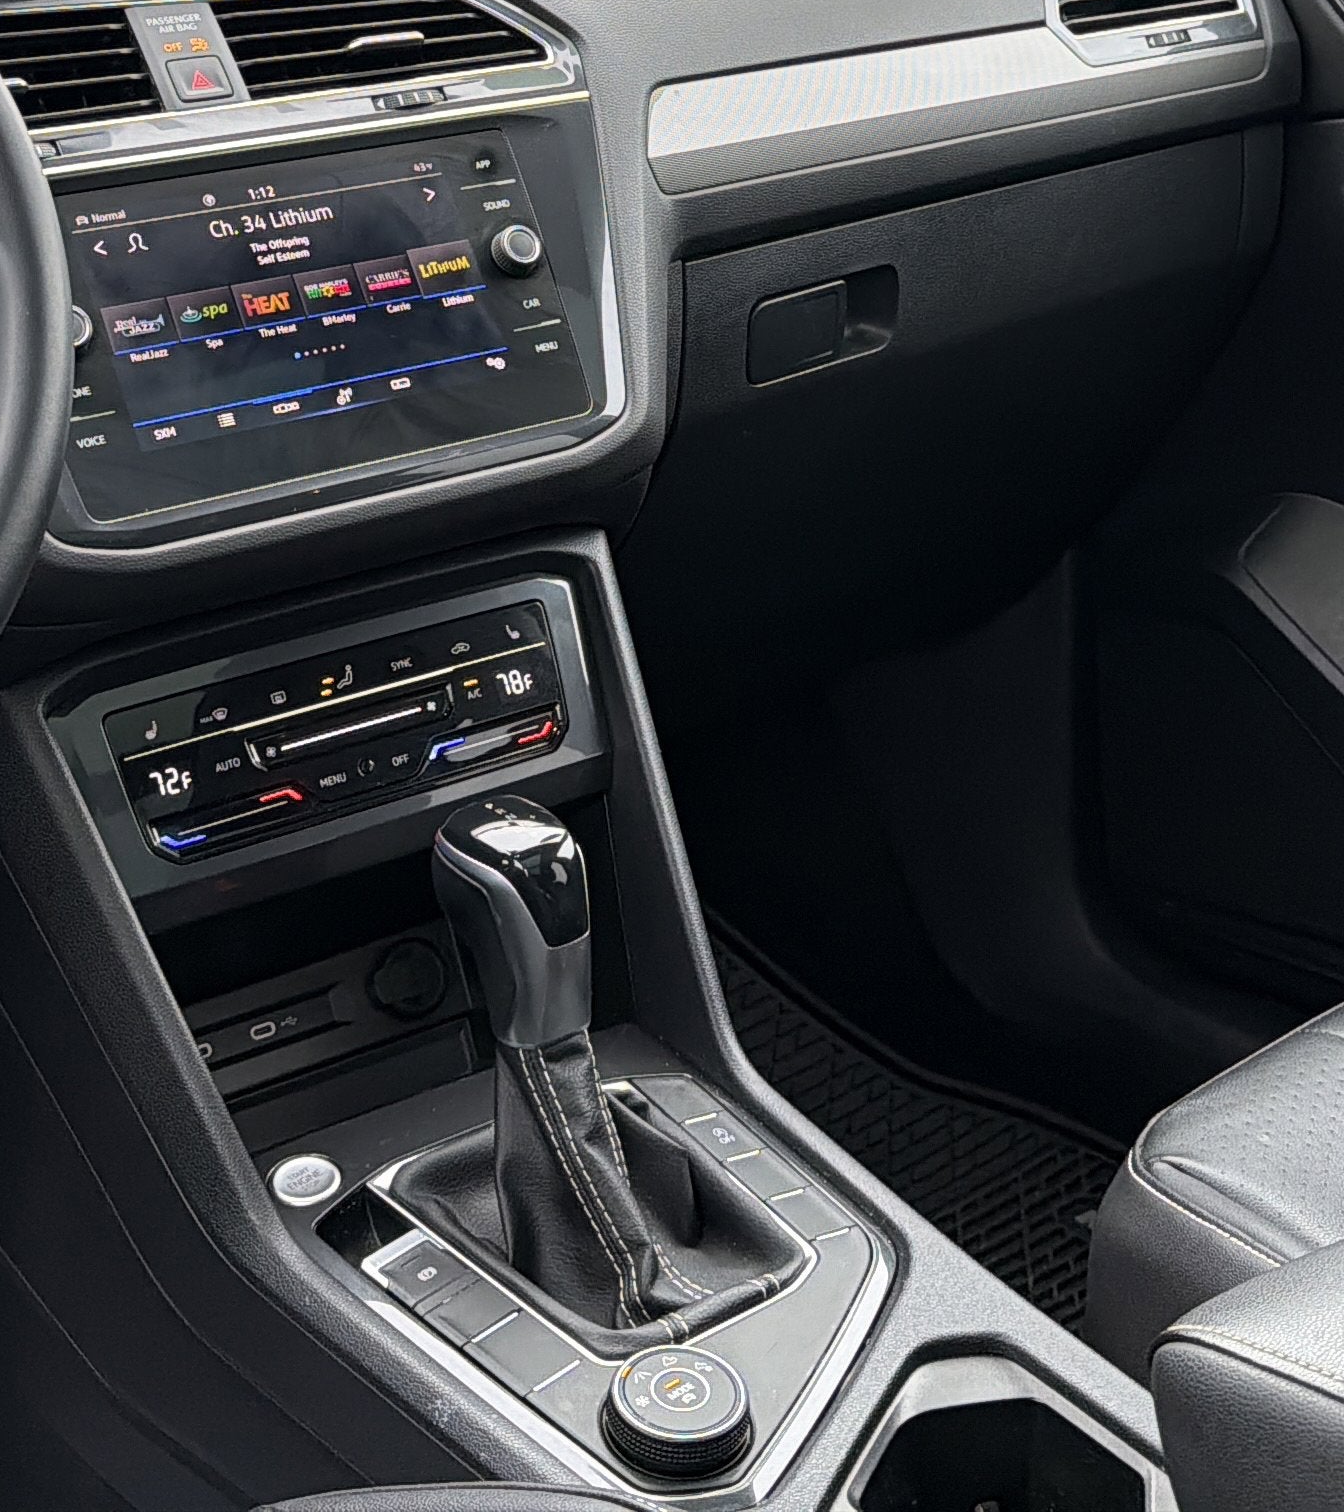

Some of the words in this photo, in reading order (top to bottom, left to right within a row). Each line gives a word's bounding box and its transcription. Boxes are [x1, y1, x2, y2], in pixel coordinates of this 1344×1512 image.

[145, 13, 202, 27] PASSENGER
[159, 25, 175, 34] AIR
[175, 23, 198, 33] BAG
[163, 41, 183, 53] OFF
[475, 159, 491, 170] APP
[247, 186, 276, 201] 1:12
[482, 199, 511, 212] SOUND
[91, 209, 127, 223] Normal
[209, 219, 239, 239] Ch.
[241, 214, 267, 234] 34
[269, 205, 334, 229] Lithium
[250, 241, 267, 253] The
[268, 235, 311, 251] Offspring
[257, 253, 277, 266] Self
[277, 248, 311, 263] Esteem
[244, 292, 292, 318] HEAT
[442, 292, 475, 308] Lithium
[522, 297, 542, 310] CAR
[202, 301, 229, 320] spa
[386, 302, 412, 314] Carrie
[128, 322, 156, 335] JAZZ
[258, 327, 276, 338] The
[277, 323, 298, 336] Heat
[205, 338, 224, 351] Spa
[534, 340, 559, 354] MENU
[71, 385, 92, 399] ONE
[153, 426, 177, 441] SXM
[76, 434, 107, 449] VOICE
[390, 656, 414, 672] SYNC
[467, 688, 483, 700] A/C
[215, 757, 241, 773] AUTO
[391, 753, 410, 767] OFF
[320, 771, 347, 788] MENU
[666, 1381, 696, 1401] MODE
